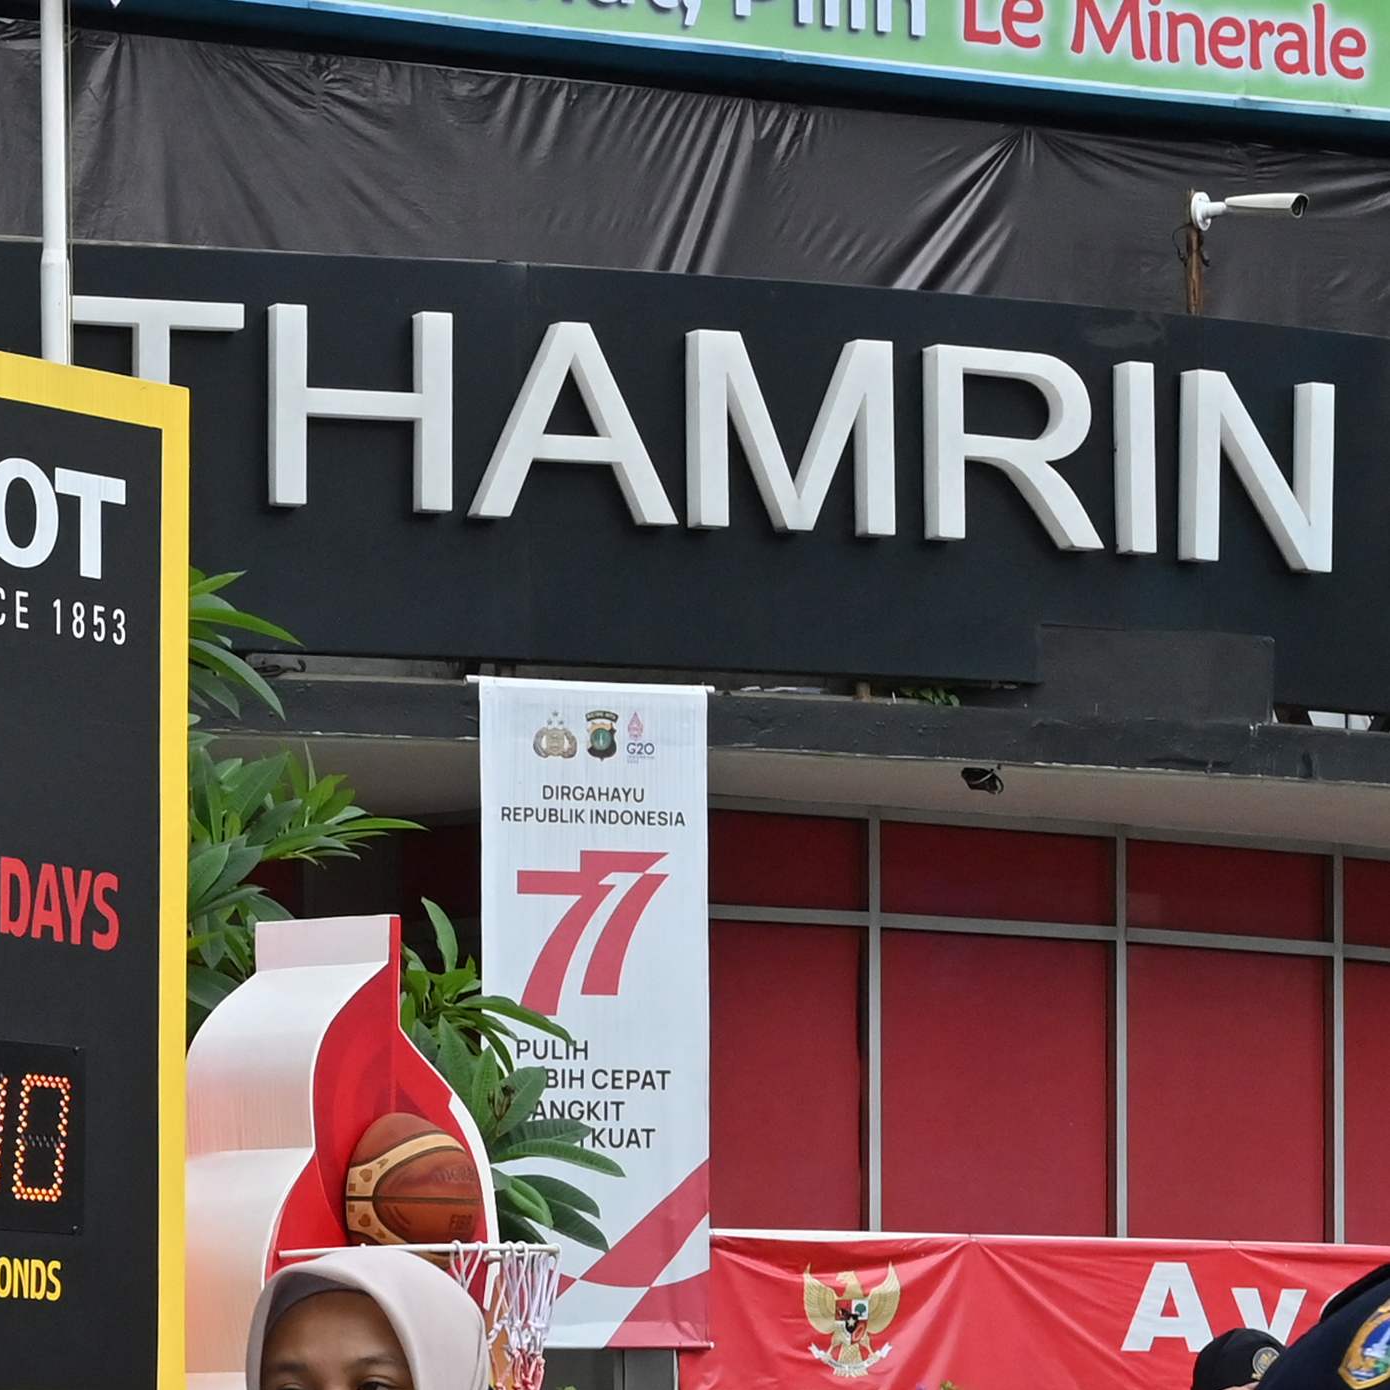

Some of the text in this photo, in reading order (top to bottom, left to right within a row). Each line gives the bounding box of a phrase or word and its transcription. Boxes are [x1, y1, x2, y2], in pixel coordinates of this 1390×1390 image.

[1070, 0, 1368, 81] Minerale
[71, 294, 1336, 574] THAMRIN
[52, 597, 129, 648] 1853
[626, 742, 655, 756] G20
[541, 783, 646, 804] DIRGAHAYU
[500, 805, 687, 828] REPUBLIK INDONESIA
[516, 849, 670, 1016] 77
[516, 1038, 590, 1061] PULIH
[544, 1068, 672, 1092] BIH CEPAT
[532, 1099, 626, 1122] ANGKIT
[591, 1127, 657, 1150] KUAT
